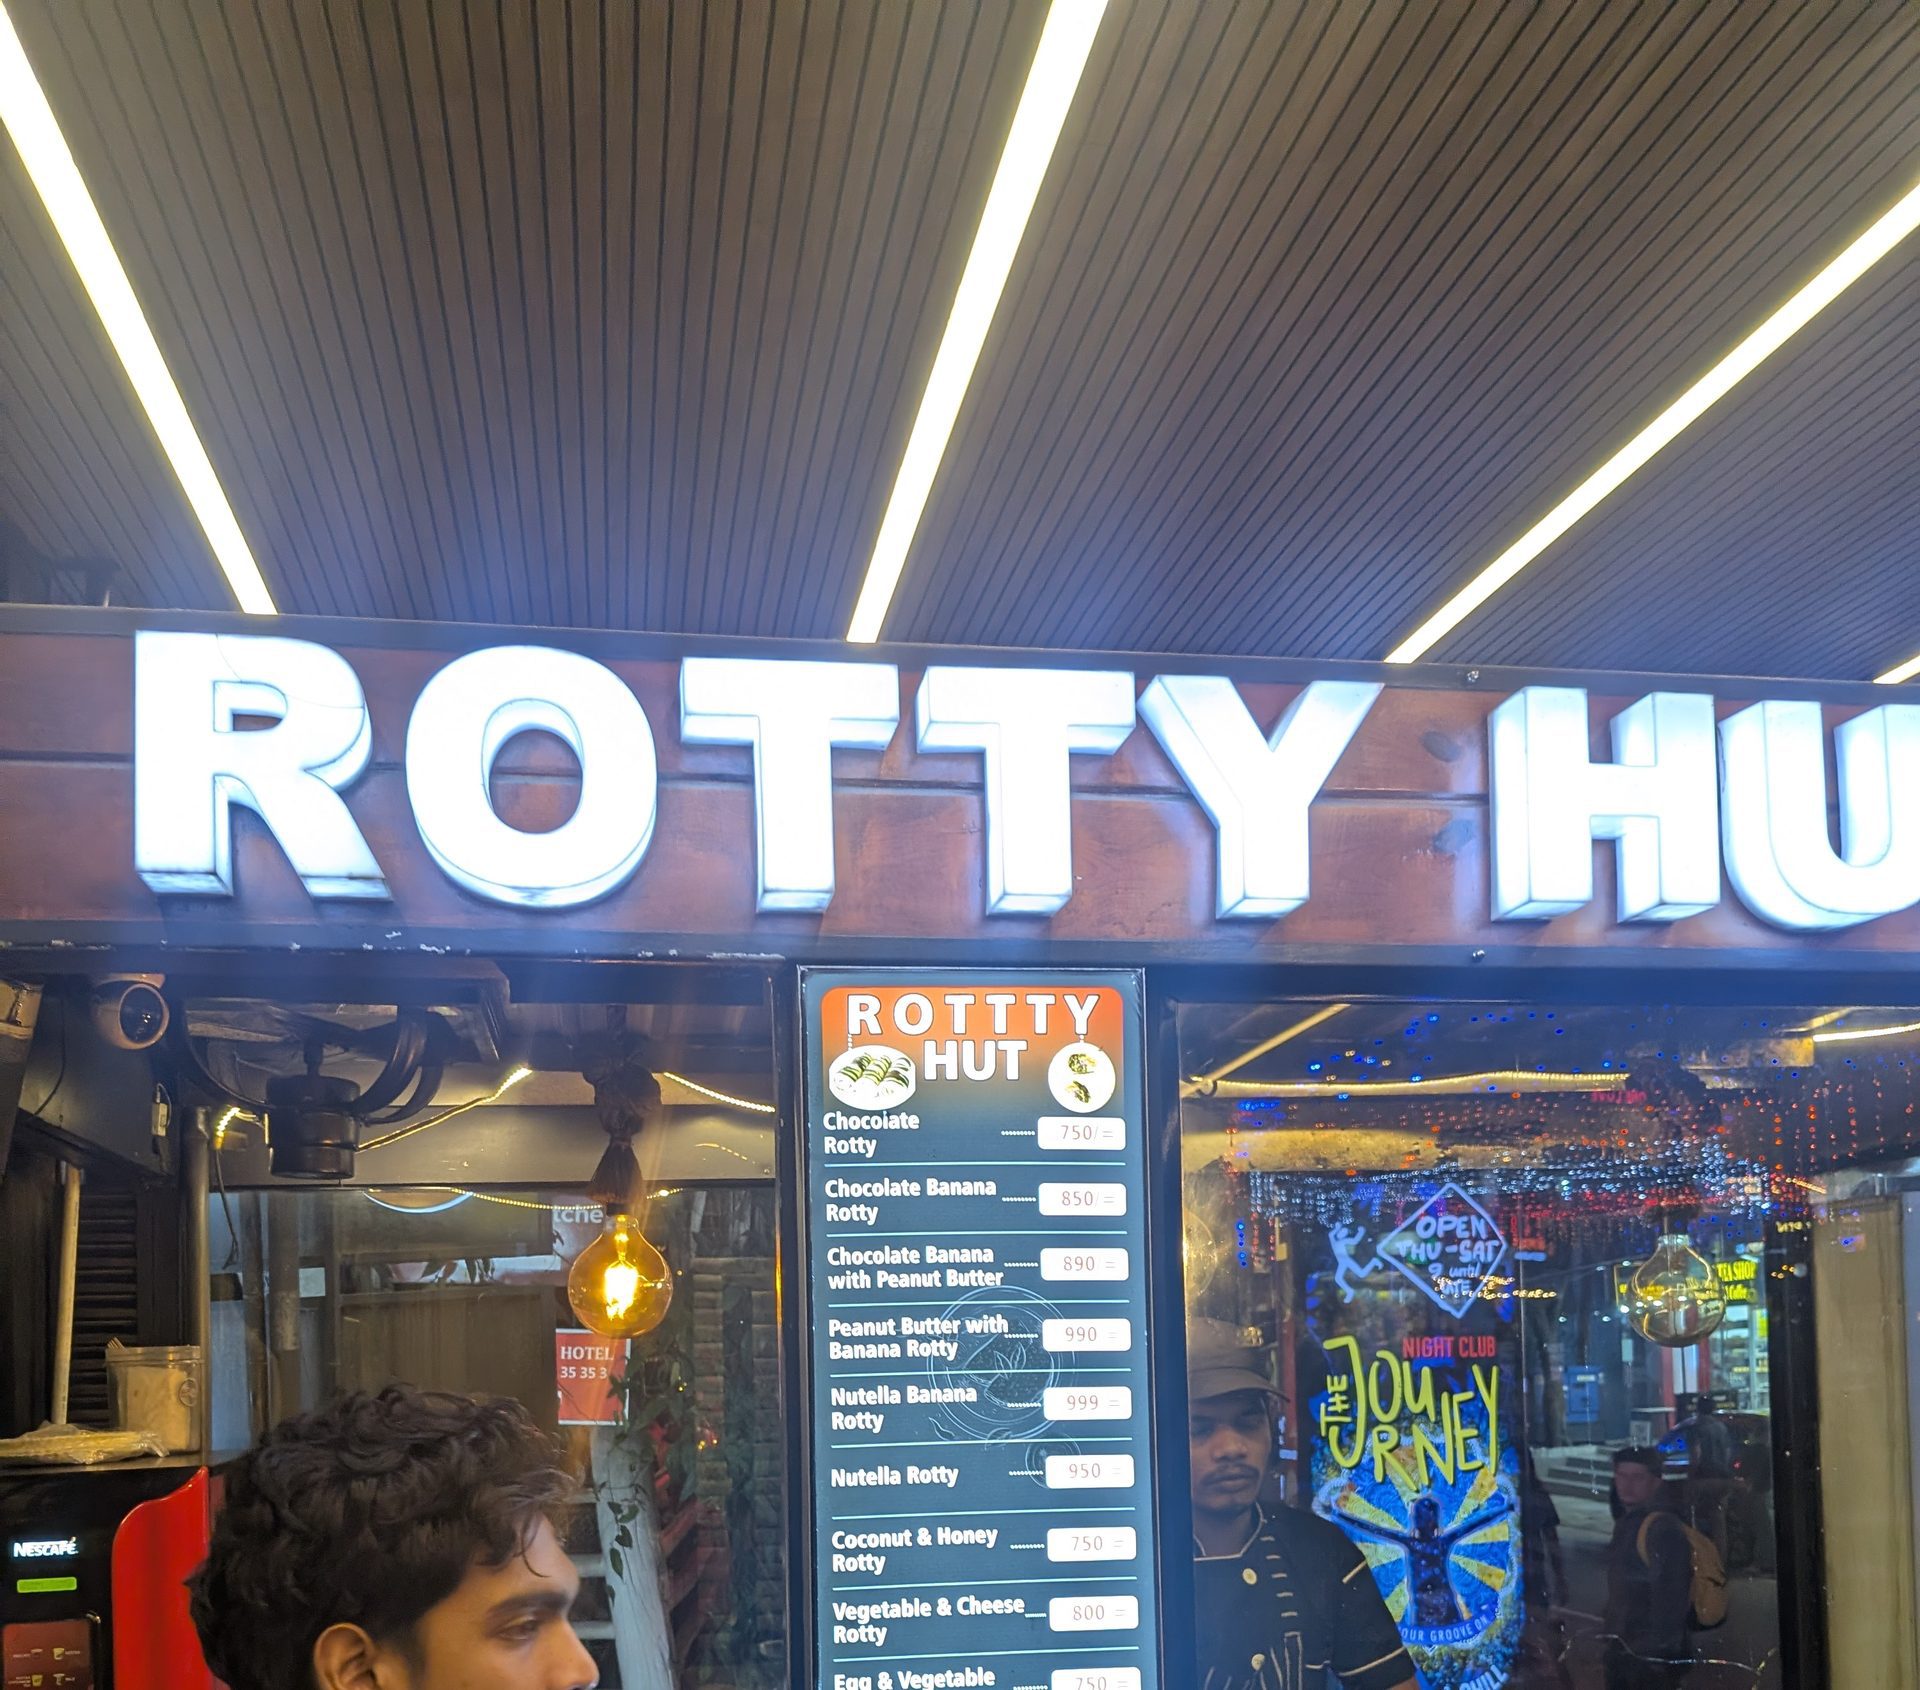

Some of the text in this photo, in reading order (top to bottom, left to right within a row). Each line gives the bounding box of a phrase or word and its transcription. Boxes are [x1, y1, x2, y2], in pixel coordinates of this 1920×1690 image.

[134, 630, 1920, 933] ROTTY HU
[847, 993, 1101, 1036] ROTTTY
[923, 1039, 1029, 1081] HUT
[822, 1111, 920, 1131] Chocolate
[824, 1136, 877, 1158] Rotty
[824, 1177, 997, 1198] Chocolate Banana
[826, 1203, 879, 1226] Rotty
[1415, 1215, 1489, 1240] OPEN
[826, 1245, 994, 1266] Chocolate Banana
[827, 1267, 1005, 1290] with Peanut Butter
[828, 1313, 1010, 1338] Peanut Butter with
[560, 1346, 614, 1360] HOTEL
[828, 1338, 959, 1362] Banana Rotty
[1402, 1336, 1496, 1358] NIGHT CLUB
[560, 1366, 577, 1378] 35
[579, 1367, 596, 1379] 35
[830, 1385, 978, 1407] Nutella Banana
[1320, 1374, 1352, 1437] THE
[831, 1411, 885, 1434] Rotty
[831, 1465, 959, 1488] Nutella Rotty
[13, 1536, 78, 1557] NESCAFÉ
[831, 1526, 999, 1550] Coconut & Honey
[832, 1553, 886, 1576] Rotty
[832, 1595, 1026, 1624] Vegetable & Cheese
[833, 1625, 888, 1647] Rotty
[1398, 1614, 1488, 1642] OUR GROOVE ON
[877, 1671, 893, 1690] &
[897, 1667, 996, 1690] Vegetable
